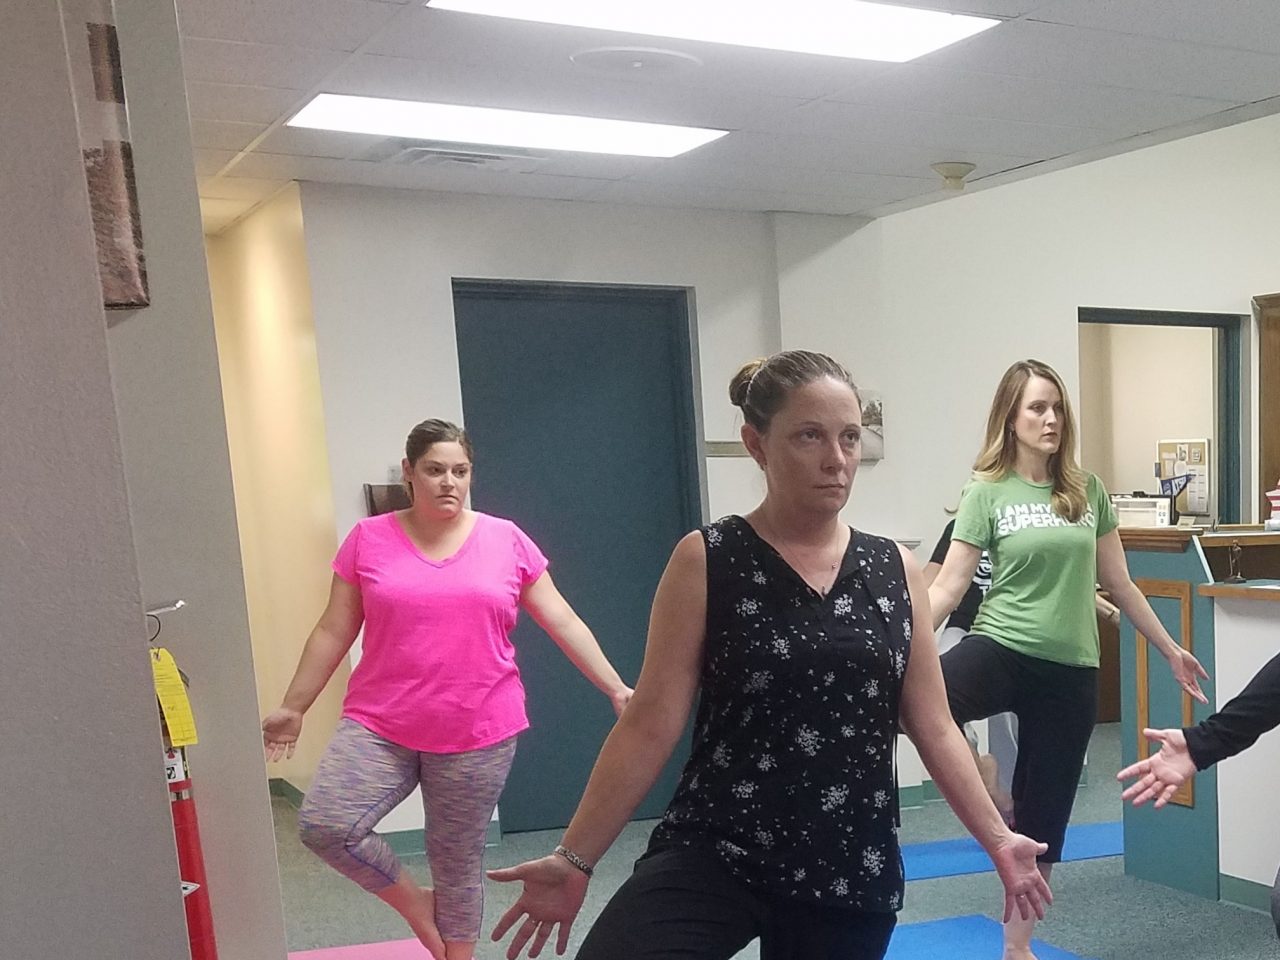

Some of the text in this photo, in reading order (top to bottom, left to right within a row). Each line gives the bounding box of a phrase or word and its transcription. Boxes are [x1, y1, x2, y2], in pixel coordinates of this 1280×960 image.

[996, 503, 1052, 520] I AM MY
[997, 512, 1095, 536] SUPERHO
